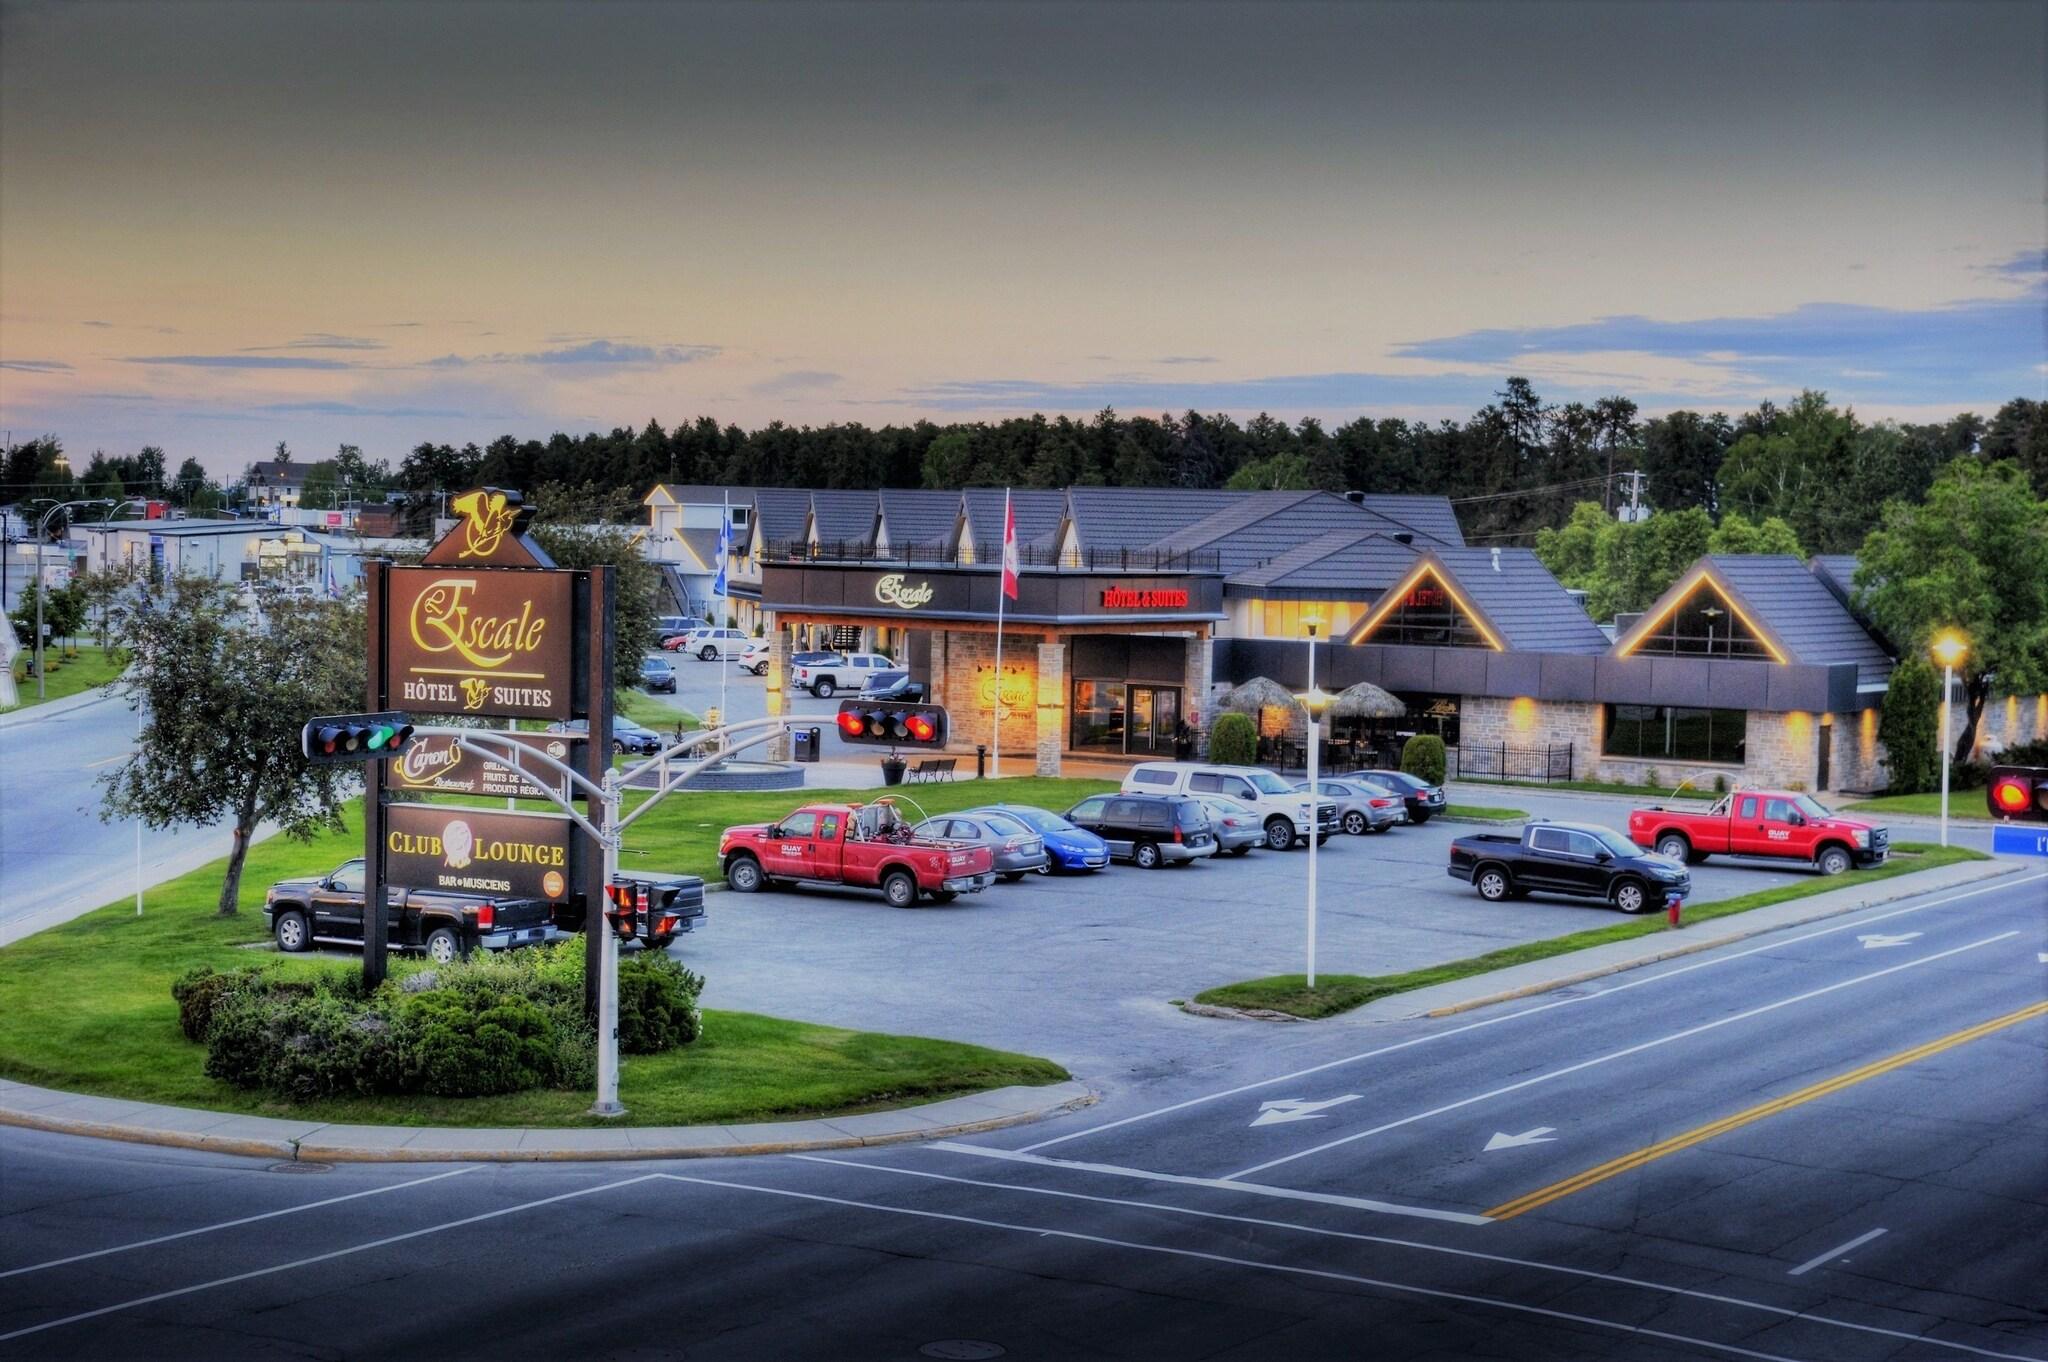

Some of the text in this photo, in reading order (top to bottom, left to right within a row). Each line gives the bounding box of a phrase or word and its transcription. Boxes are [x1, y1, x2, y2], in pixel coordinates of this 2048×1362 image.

[1103, 584, 1188, 608] HÔTEL & SUITES
[404, 678, 552, 708] HÔTEL SUITES
[404, 737, 453, 778] Caron
[482, 784, 518, 794] PRODUITS
[483, 773, 507, 783] FRUITS
[509, 774, 520, 783] DE
[389, 831, 565, 866] CLUB LOUNGE
[438, 875, 511, 892] BAR MUSICIENS
